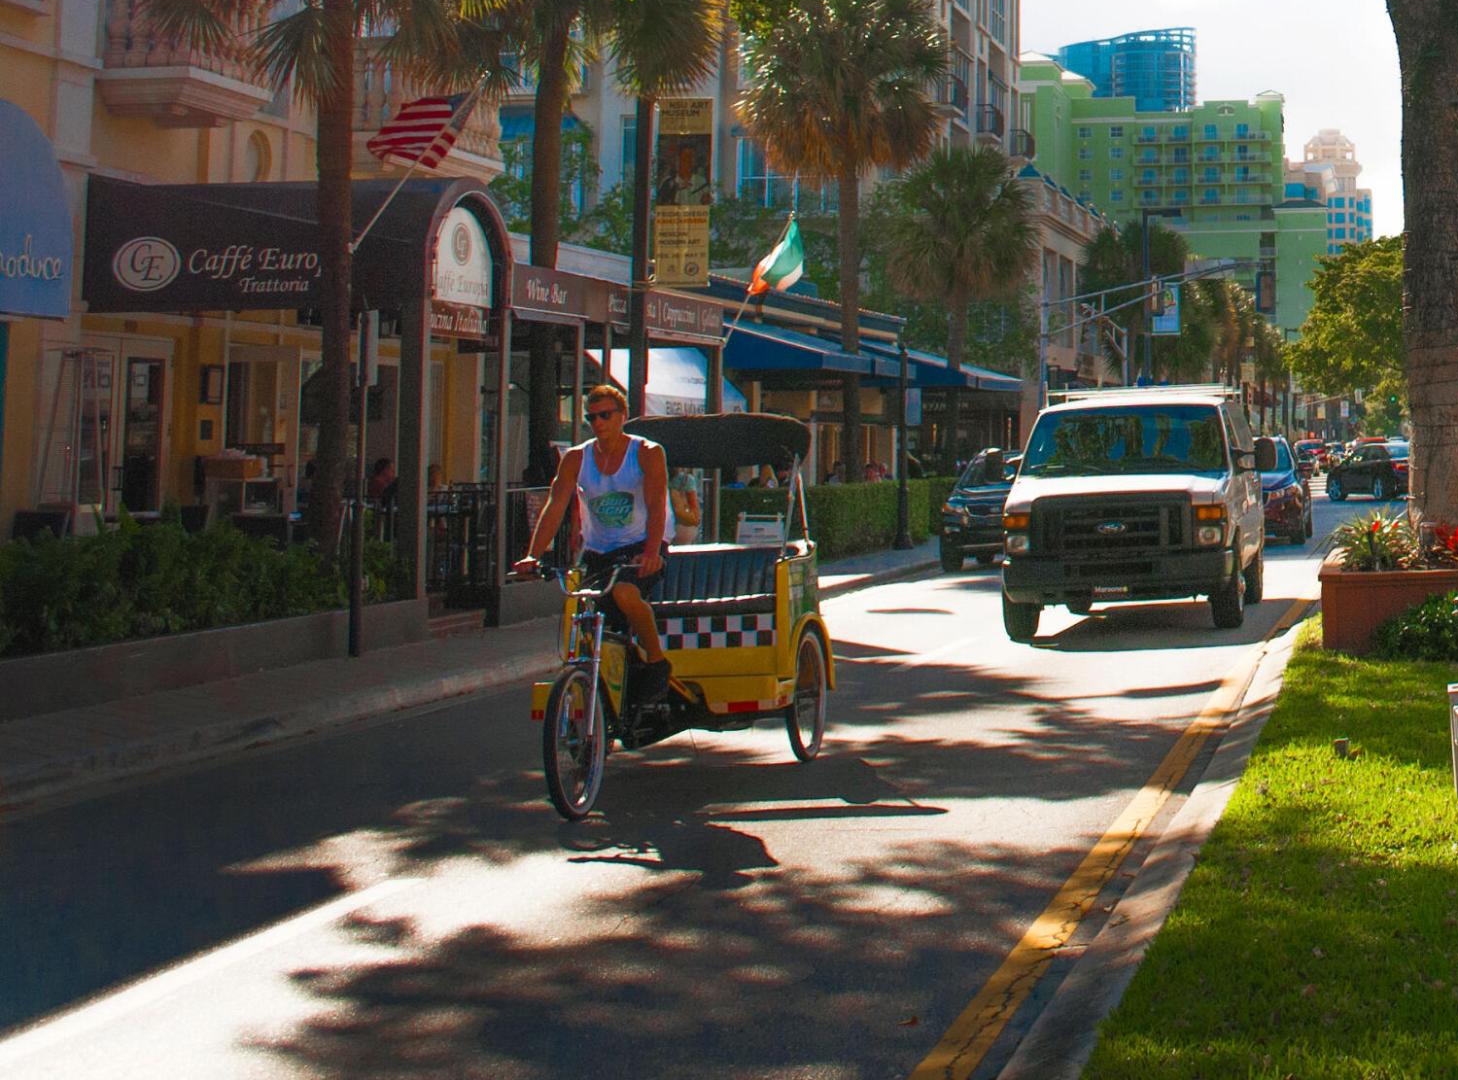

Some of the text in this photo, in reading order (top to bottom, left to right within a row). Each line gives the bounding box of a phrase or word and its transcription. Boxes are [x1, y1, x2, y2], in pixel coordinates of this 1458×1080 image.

[188, 245, 322, 279] Caffé Euro
[239, 276, 309, 294] Trattoria
[527, 278, 568, 305] Wine Bar
